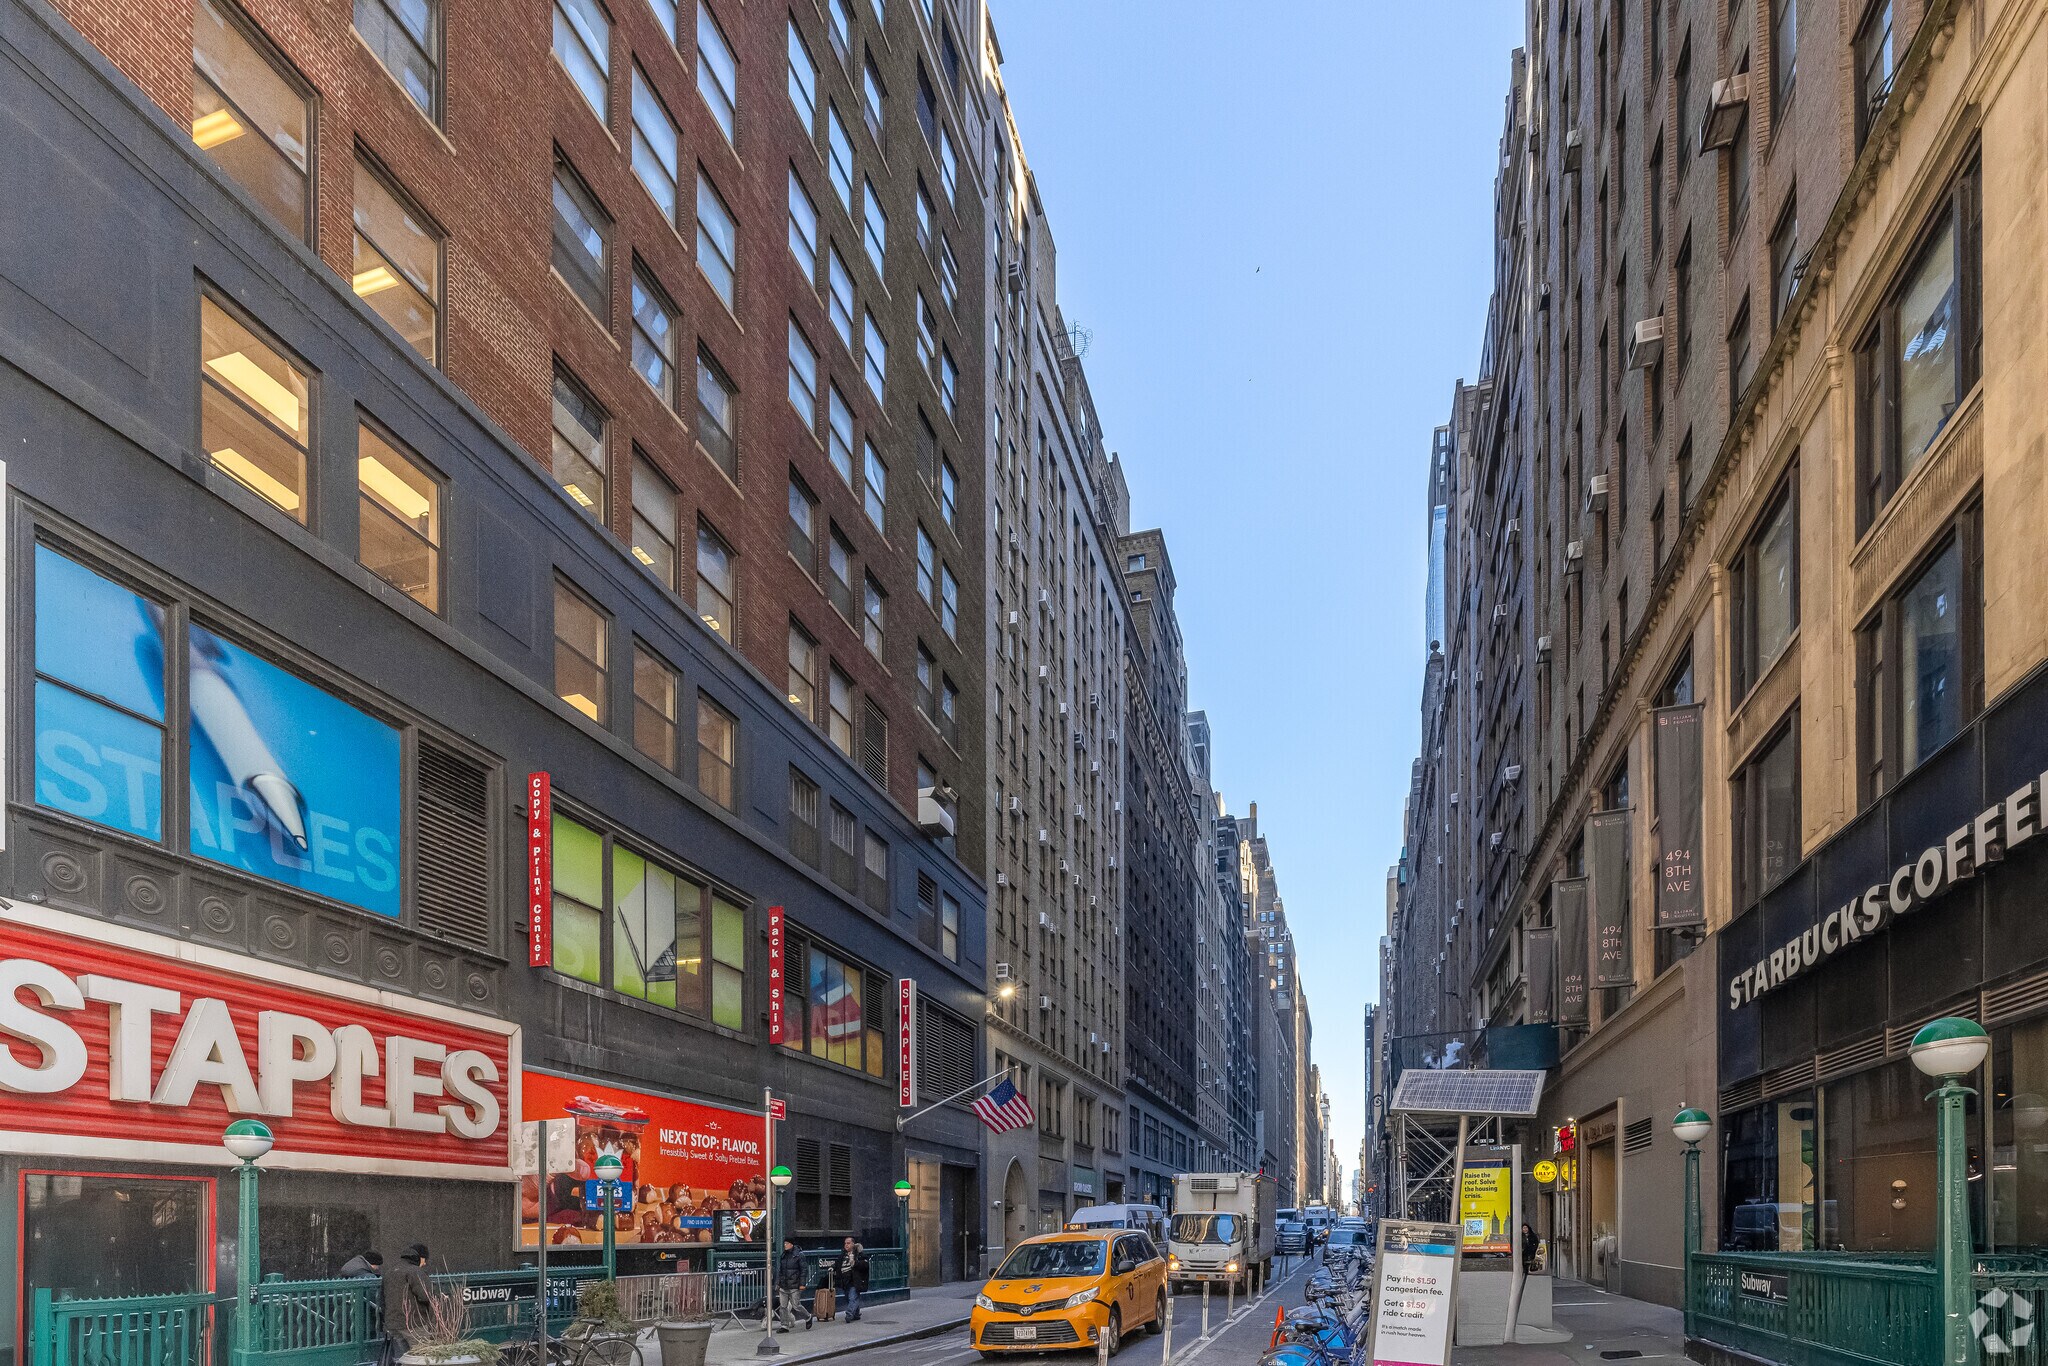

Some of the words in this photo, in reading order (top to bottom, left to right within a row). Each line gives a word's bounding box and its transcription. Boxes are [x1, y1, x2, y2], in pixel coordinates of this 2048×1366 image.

[532, 778, 541, 820] Copy
[532, 829, 541, 838] &
[1666, 849, 1690, 861] 494
[533, 847, 542, 896] Print
[1665, 864, 1692, 878] 8TH
[1666, 880, 1691, 892] AVE
[533, 904, 542, 961] Center
[1602, 925, 1622, 935] 494
[771, 916, 779, 958] Pack
[1602, 938, 1622, 948] 8TH
[1730, 883, 1886, 1010] STARBUCKS
[1602, 950, 1622, 960] AVE
[771, 969, 779, 978] &
[1565, 975, 1582, 983] 494
[1565, 984, 1583, 993] 8TH
[1565, 994, 1582, 1003] AVE
[0, 958, 500, 1139] STAPLES
[902, 988, 910, 1098] STAPLES
[660, 1128, 688, 1146] NEXT
[690, 1132, 720, 1150] STOP:
[722, 1137, 760, 1155] FLAVOR.
[660, 1146, 689, 1160] Irresistibly
[690, 1149, 707, 1160] Sweet
[709, 1152, 714, 1161] &
[714, 1152, 728, 1165] Salty
[729, 1154, 746, 1164] Pretzel
[1475, 1185, 1498, 1193] housing
[728, 1260, 748, 1268] Street
[1386, 1274, 1401, 1283] Pay
[1402, 1275, 1415, 1283] the
[1416, 1277, 1436, 1285] $1.50
[1741, 1272, 1771, 1297] Subway
[463, 1287, 512, 1302] Subway
[1385, 1285, 1428, 1294] congestion
[1430, 1287, 1444, 1296] fee.
[1384, 1298, 1399, 1307] Get
[1406, 1301, 1426, 1309] $1.50
[1383, 1309, 1399, 1317] ride
[1399, 1311, 1425, 1319] credit.
